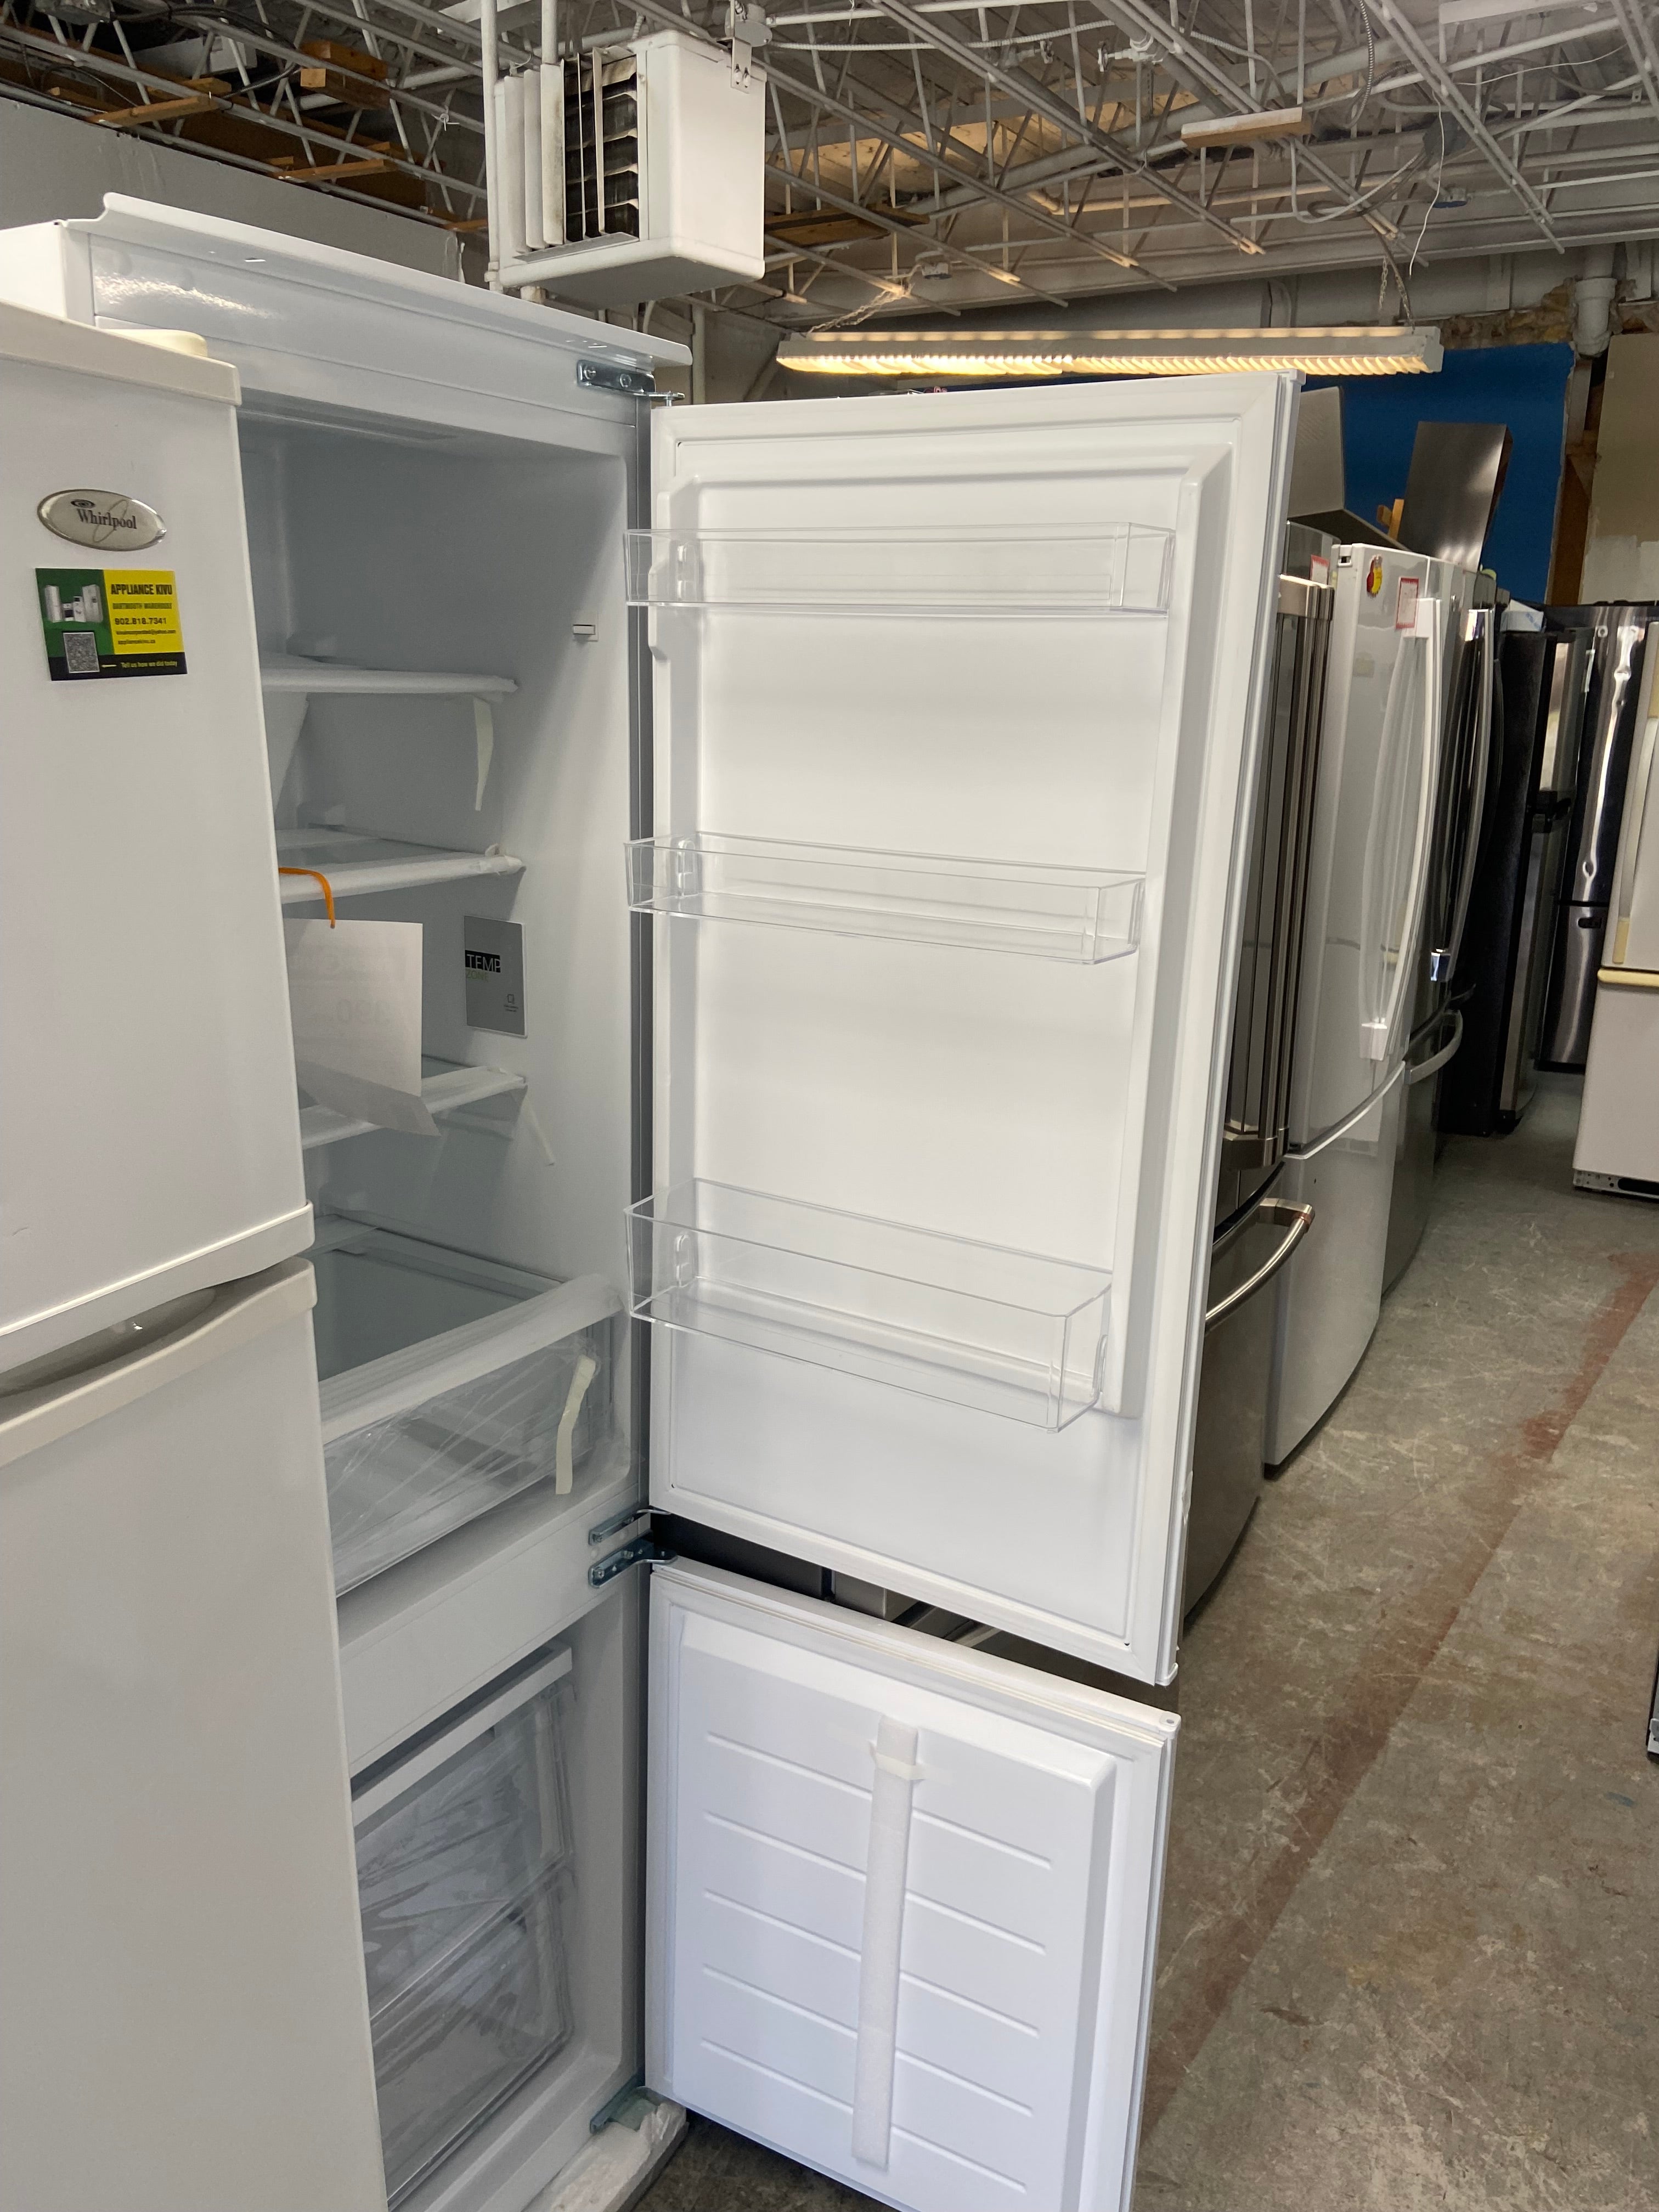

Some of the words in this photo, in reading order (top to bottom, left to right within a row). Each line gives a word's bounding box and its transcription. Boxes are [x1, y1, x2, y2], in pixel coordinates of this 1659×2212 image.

[76, 509, 137, 531] Whirlpool
[111, 584, 154, 595] APPLIANCE
[155, 584, 173, 595] KIVU
